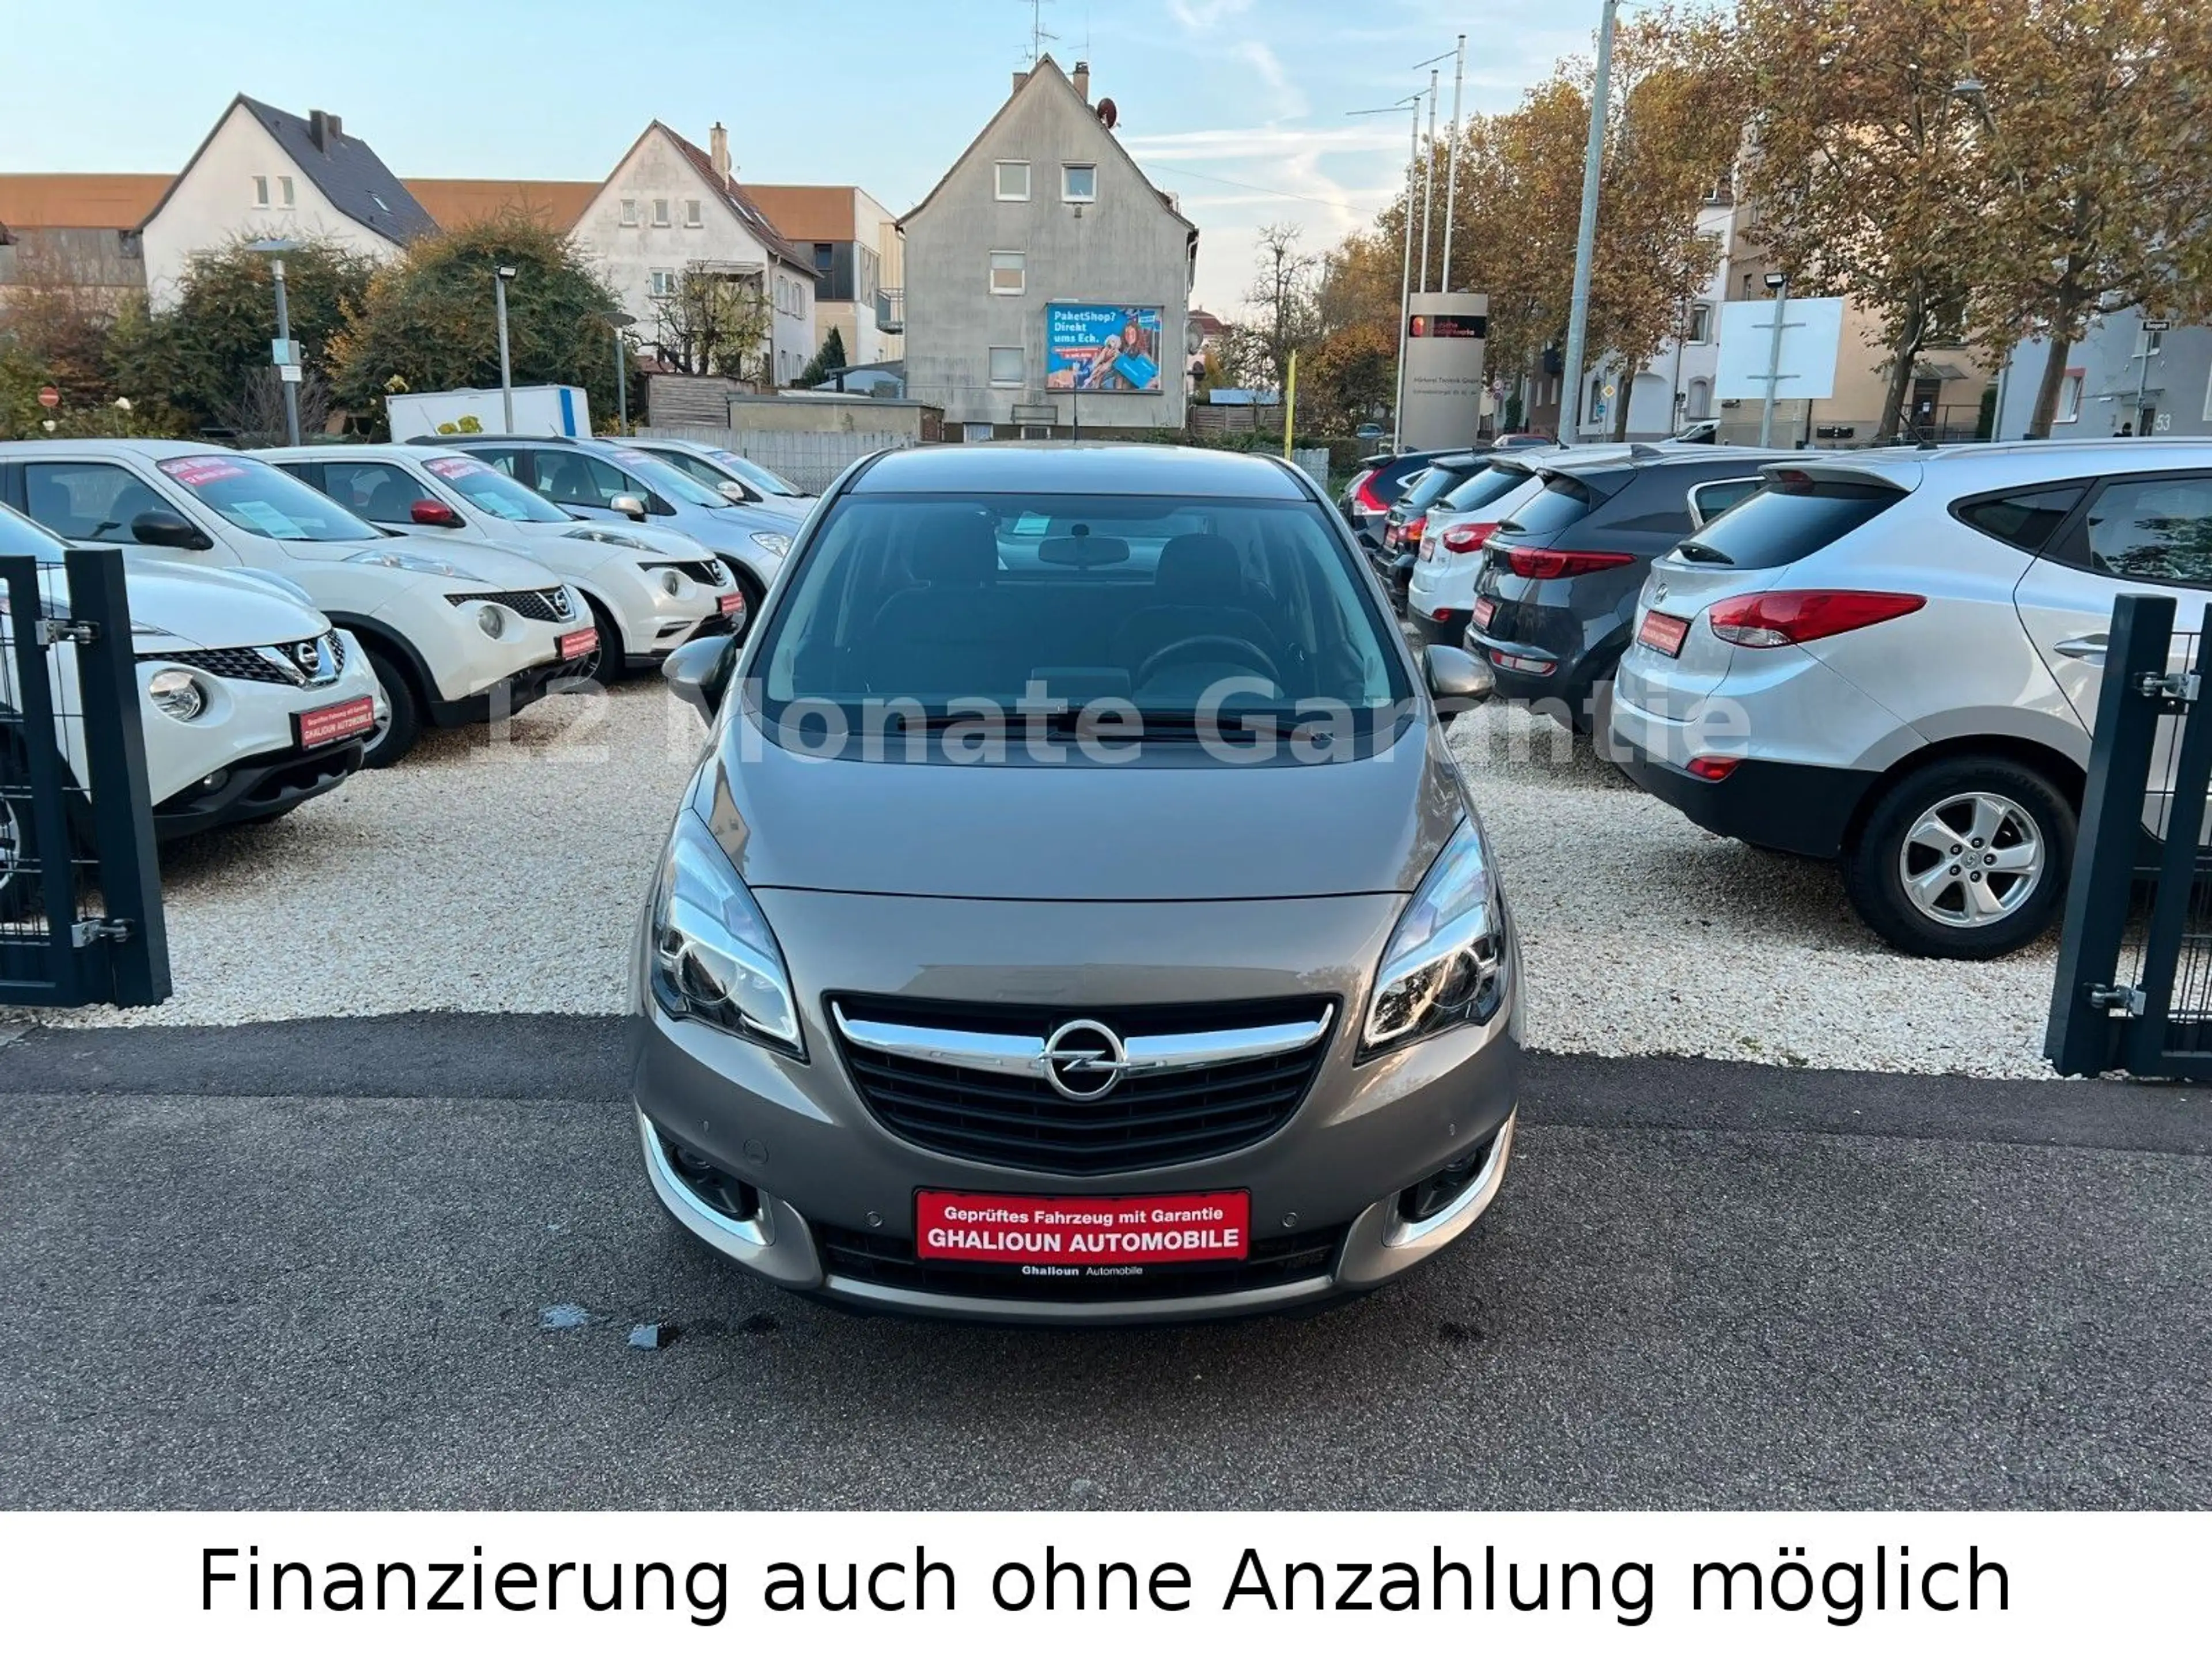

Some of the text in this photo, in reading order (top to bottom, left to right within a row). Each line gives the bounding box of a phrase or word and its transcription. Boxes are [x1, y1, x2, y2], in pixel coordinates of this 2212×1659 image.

[1054, 310, 1116, 323] PaketShop?
[1054, 322, 1087, 332] Direkt
[2156, 414, 2171, 431] 53
[944, 1206, 1224, 1226] Geprüftes Fahrzeug mit Garantie
[927, 1228, 1239, 1253] GHALIOUN AUTOMOBILE
[1022, 1265, 1143, 1276] Ghalioun Automobile
